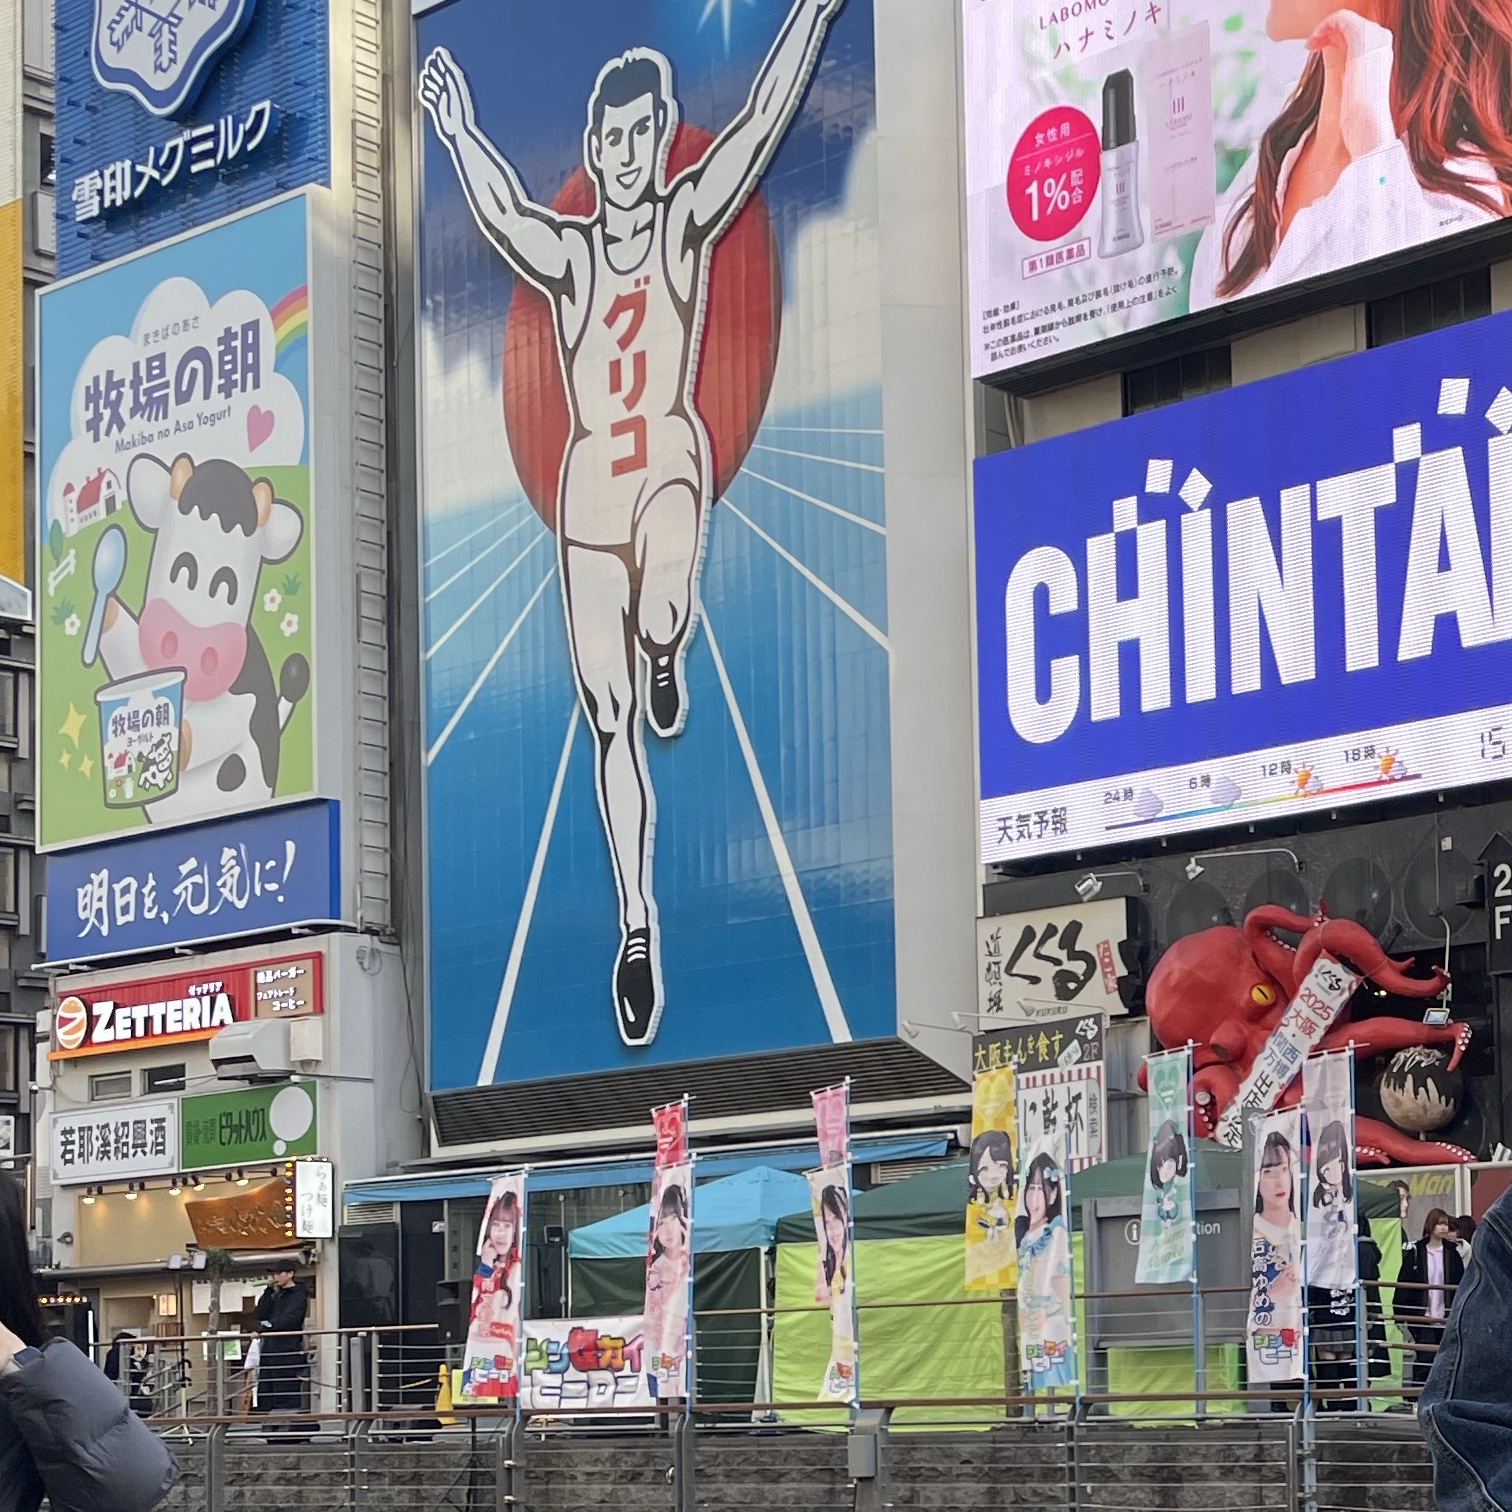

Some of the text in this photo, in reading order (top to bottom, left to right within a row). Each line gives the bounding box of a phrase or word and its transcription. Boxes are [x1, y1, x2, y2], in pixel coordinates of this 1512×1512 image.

[1053, 2, 1161, 59] ハナミノキ
[1034, 122, 1070, 147] 女性用
[72, 99, 271, 222] 雪印メグミルク
[1025, 172, 1069, 221] 1%
[1071, 168, 1084, 205] 配合
[143, 316, 199, 347] まきばのあさ
[85, 318, 261, 443] 牧場の朝
[602, 275, 650, 477] グリコ
[115, 405, 232, 453] Makiba no Asa Yogurt
[112, 703, 169, 738] 牧場の朝
[1189, 774, 1212, 790] 6時
[1261, 759, 1292, 778] 12時
[1104, 787, 1134, 804] 24時
[997, 806, 1068, 844] 天気予報
[985, 927, 1004, 1015] 道頓堀
[1004, 920, 1097, 1001] くくる
[92, 993, 233, 1043] ZETTERIA
[272, 998, 305, 1012] コーヒー
[1036, 1006, 1068, 1017] KUKURU
[1300, 987, 1335, 1020] 2025
[1083, 1042, 1099, 1061] 2F
